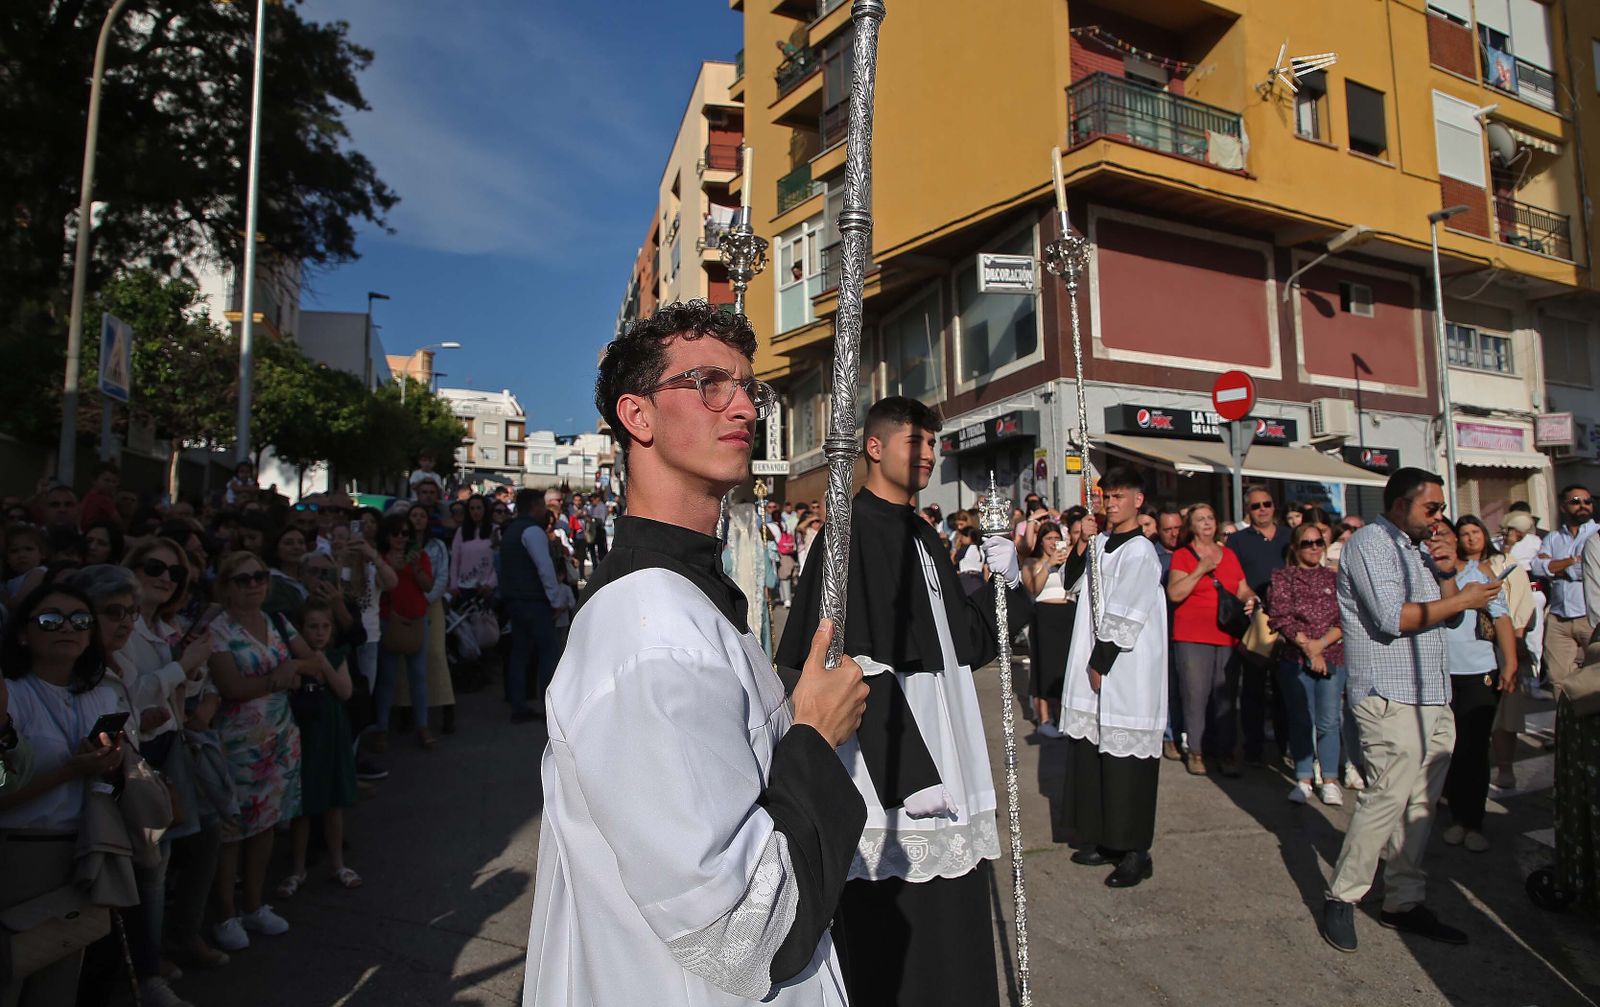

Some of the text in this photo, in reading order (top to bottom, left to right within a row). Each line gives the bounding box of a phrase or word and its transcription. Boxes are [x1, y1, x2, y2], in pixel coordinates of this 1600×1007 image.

[1191, 411, 1205, 424] LA
[1192, 424, 1202, 433] DE
[1202, 425, 1211, 434] LA
